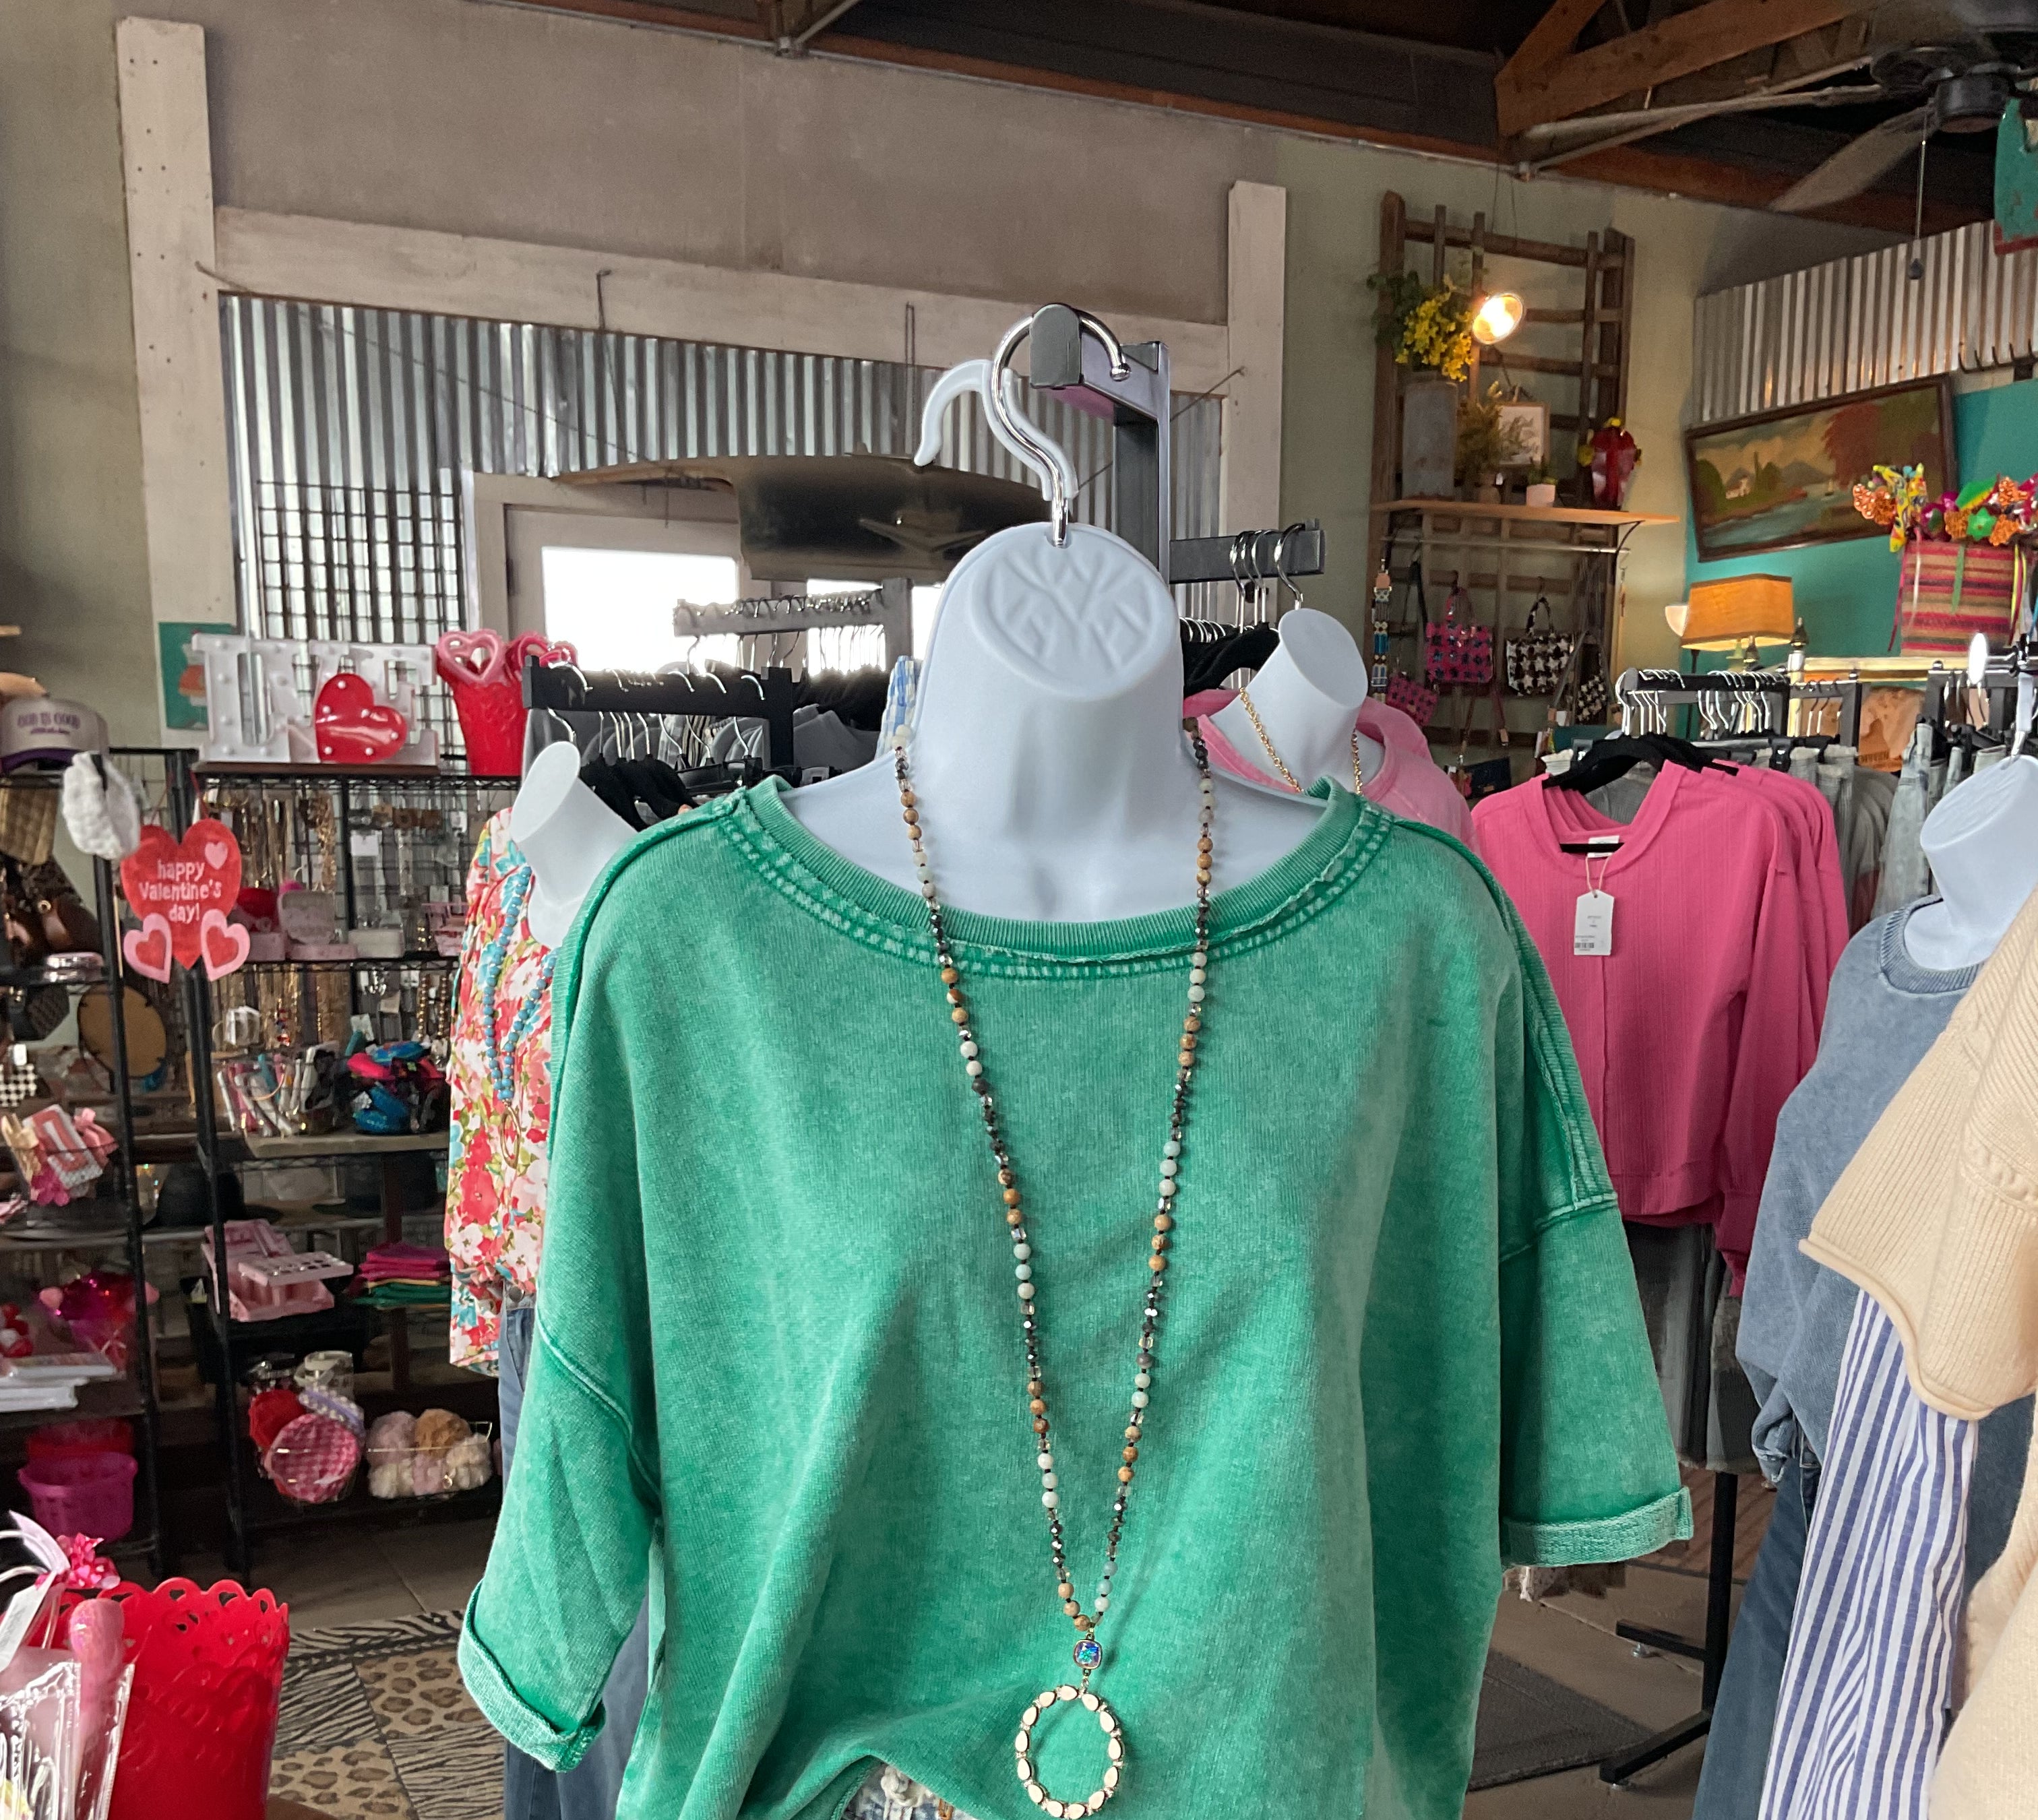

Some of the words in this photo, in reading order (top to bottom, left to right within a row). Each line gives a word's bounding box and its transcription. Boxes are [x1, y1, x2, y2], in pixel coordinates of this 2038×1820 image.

[158, 859, 205, 881] happy
[139, 879, 222, 901] Valentine's
[169, 903, 200, 924] day!
